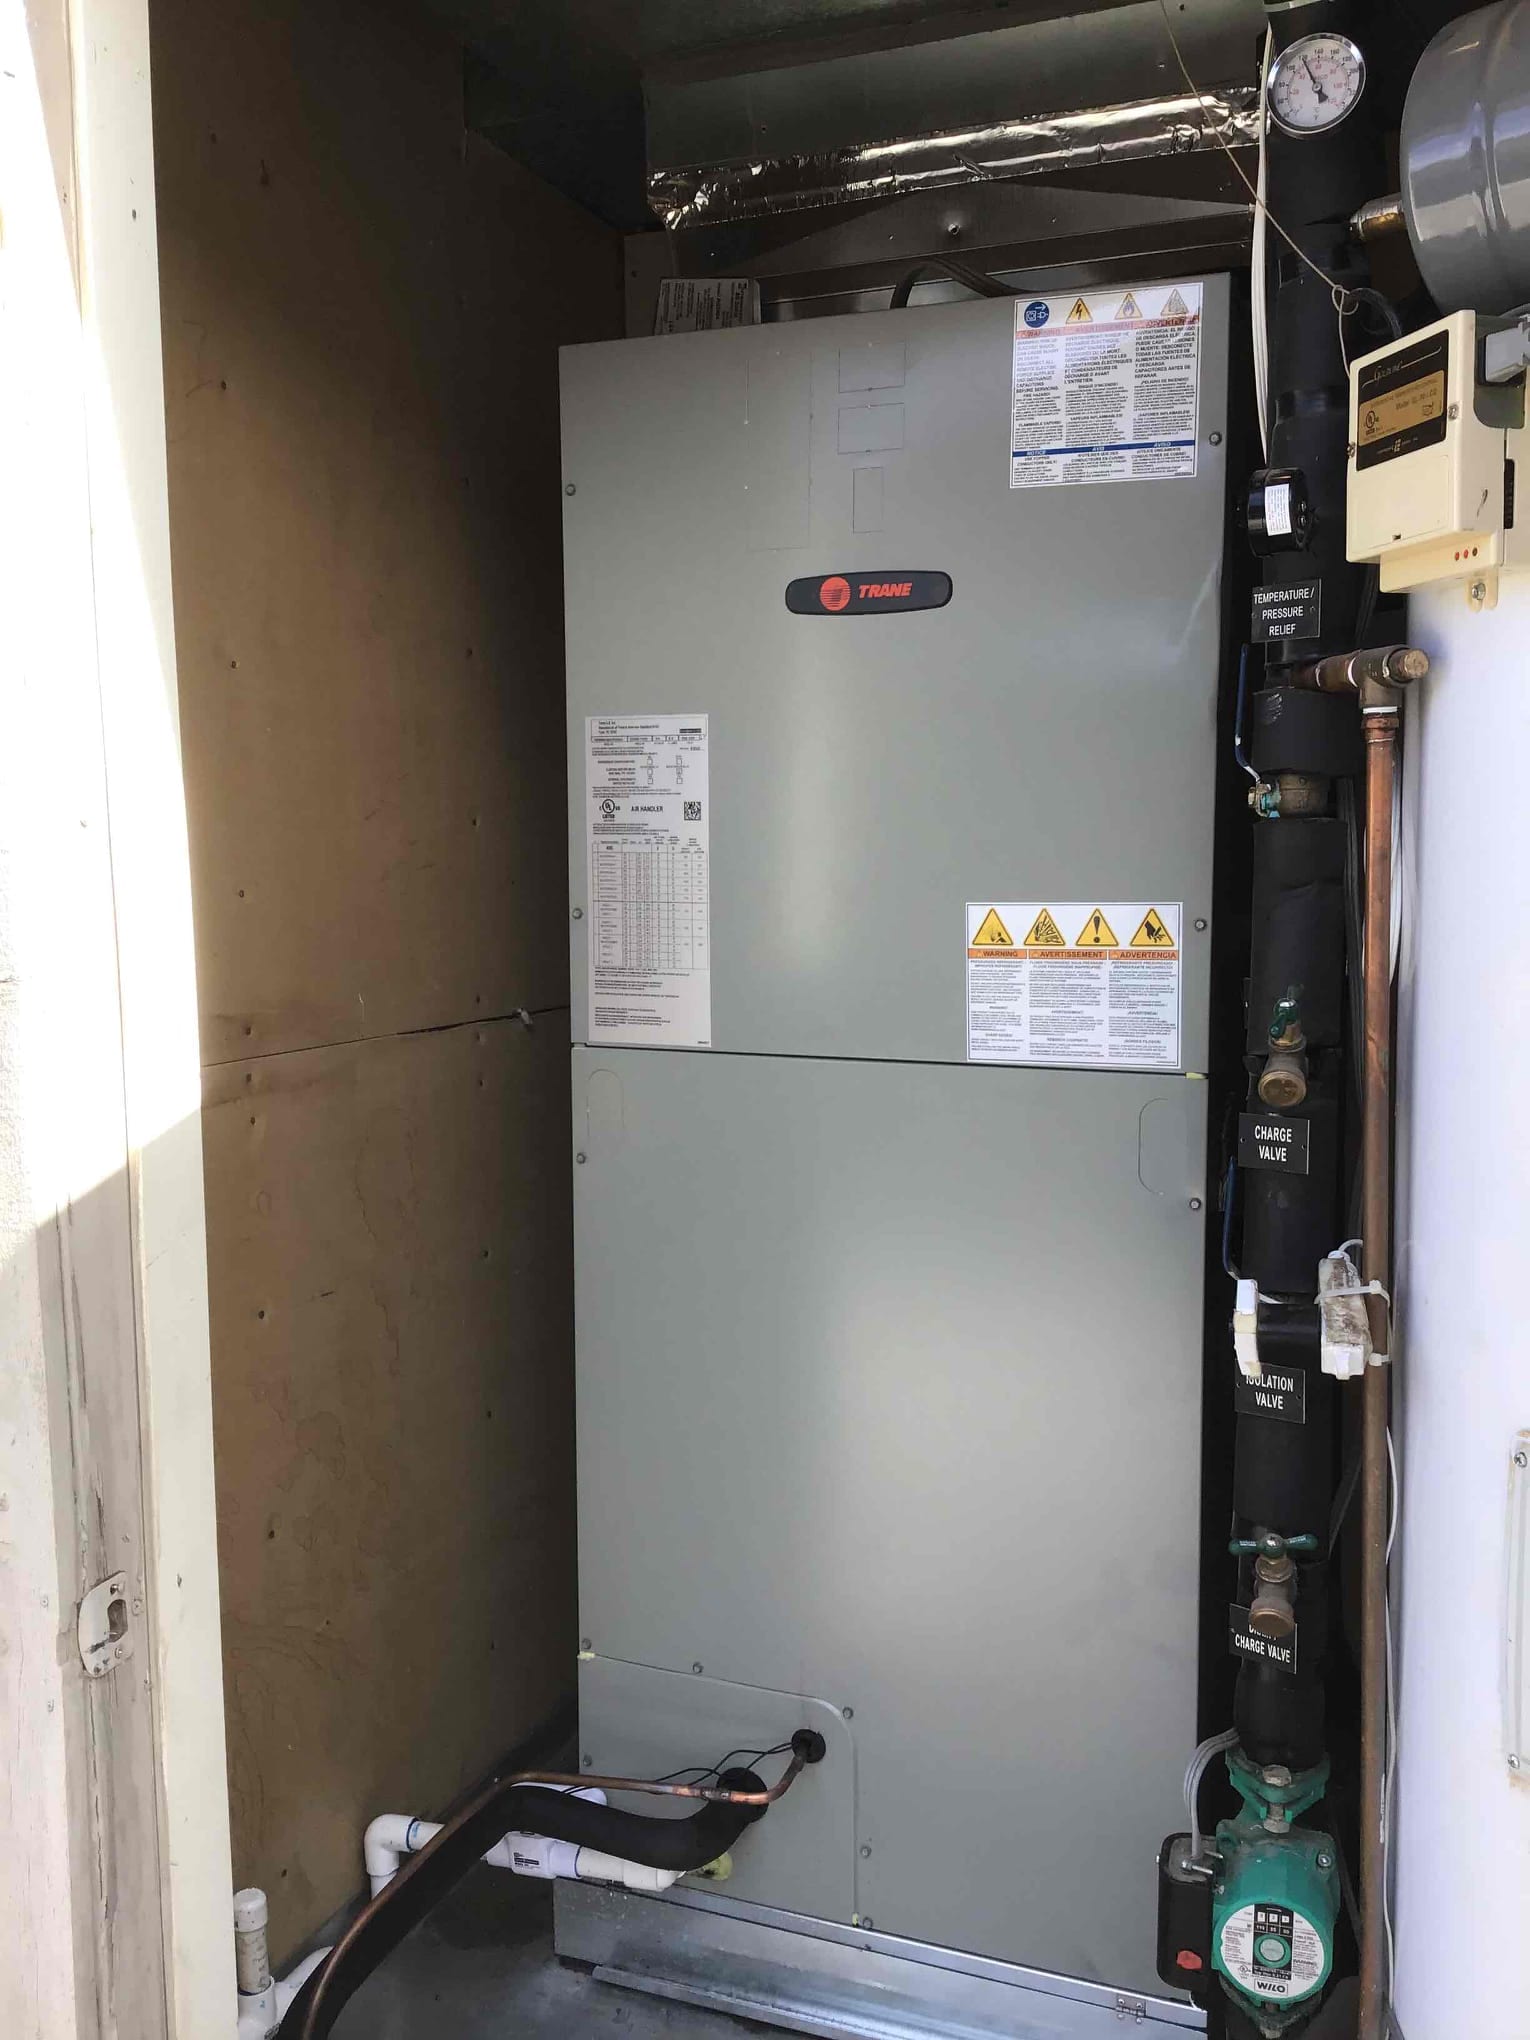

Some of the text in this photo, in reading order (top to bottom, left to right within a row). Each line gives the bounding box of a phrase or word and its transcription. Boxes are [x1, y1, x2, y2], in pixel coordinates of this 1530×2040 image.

[859, 582, 912, 598] TRANE
[1262, 606, 1304, 620] PRESSURE
[1269, 624, 1296, 636] RELIEF
[1040, 950, 1104, 959] AVERTISSEMENT
[1120, 951, 1176, 959] ADVERTENCIA
[1254, 1125, 1292, 1142] CHARGE
[1258, 1145, 1287, 1162] VALVE
[1255, 1392, 1284, 1409] VALVE
[1235, 1634, 1291, 1663] CHARGE VALVE
[1257, 1981, 1285, 1993] WILO
